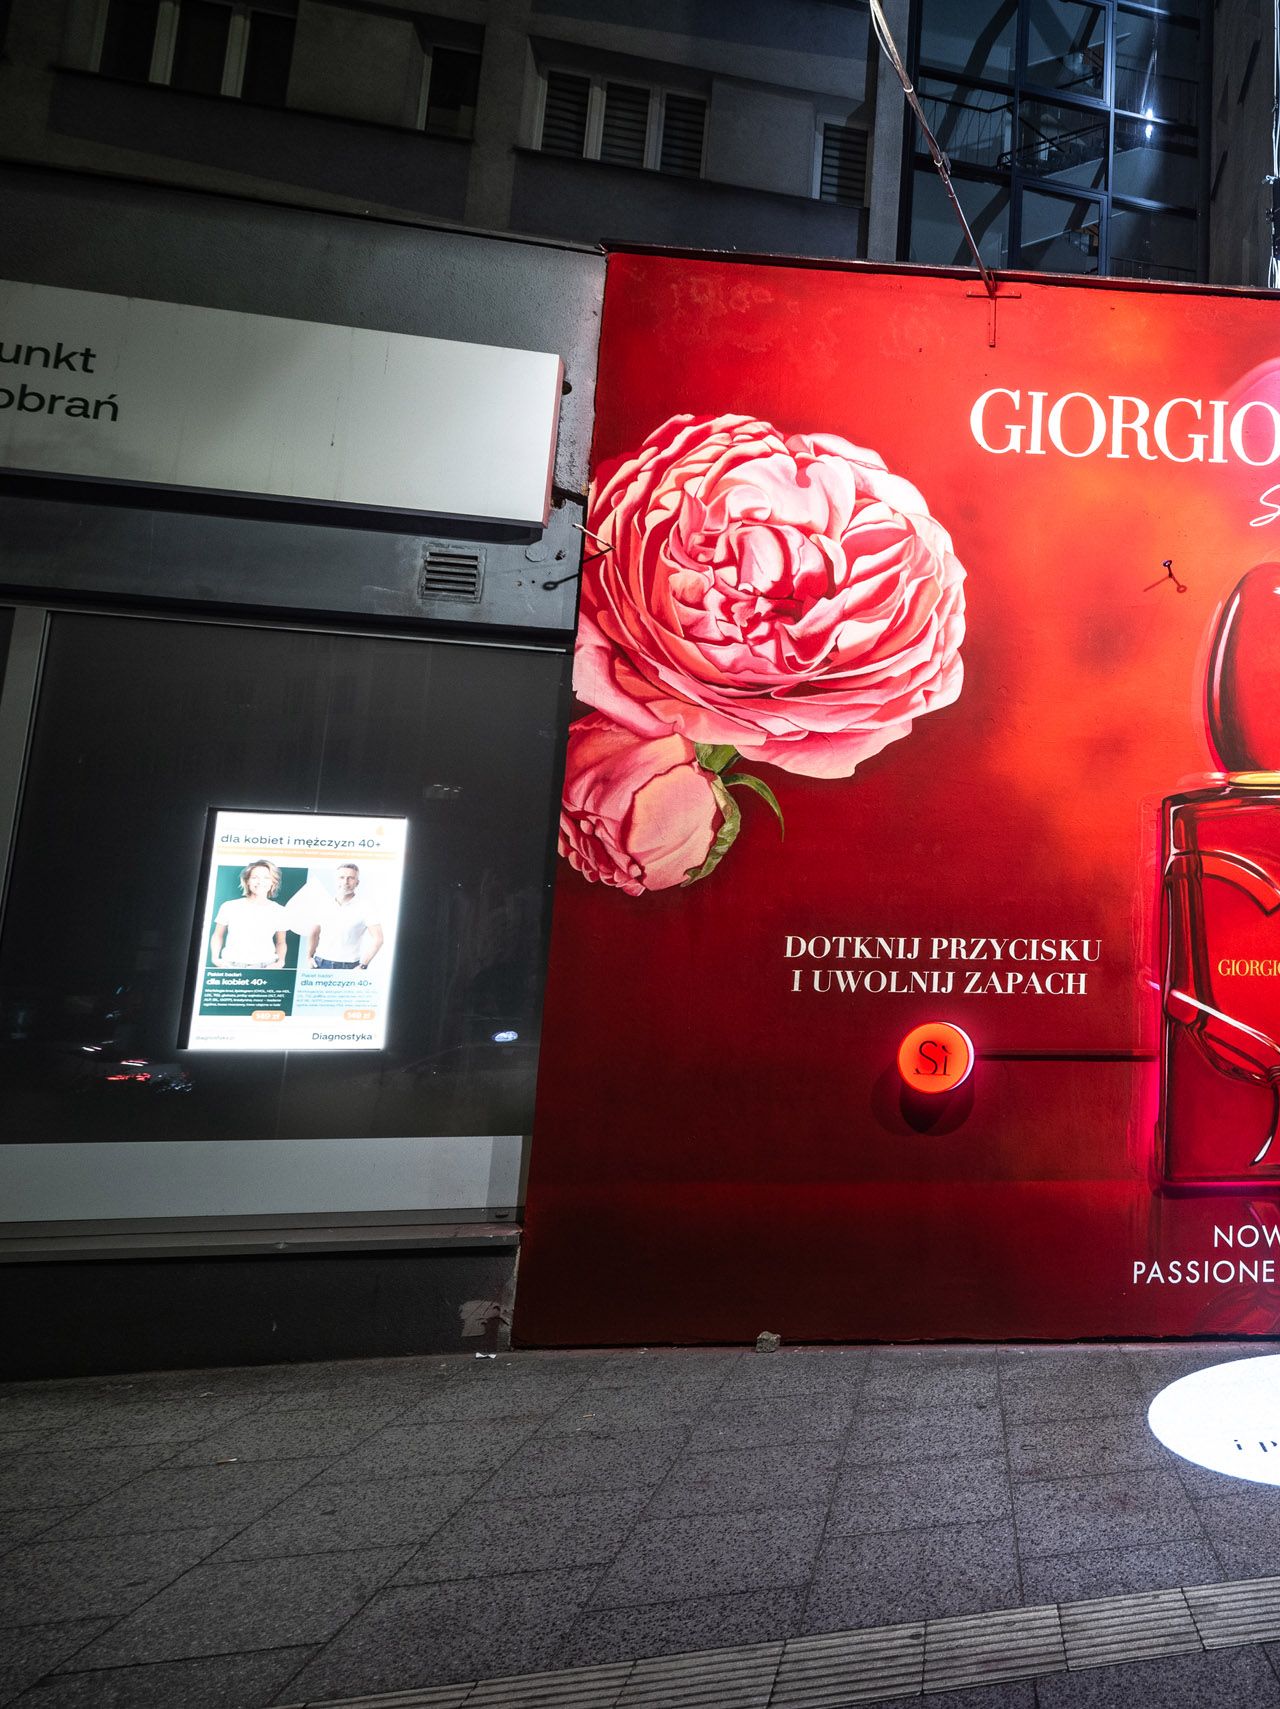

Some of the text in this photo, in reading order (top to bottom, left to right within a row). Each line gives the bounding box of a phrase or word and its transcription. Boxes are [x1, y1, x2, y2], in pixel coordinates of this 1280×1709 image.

[220, 834, 381, 850] dla kobiet i mężczyzn 40+
[784, 935, 1102, 962] DOTKNIJ PRZYCISKU
[206, 978, 268, 986] dla kobiet 40+
[300, 979, 373, 988] dla mężczyzn 40+
[791, 969, 1088, 995] I UWOLNIJ ZAPACH
[312, 1032, 373, 1042] Diagnostyka
[913, 1039, 952, 1075] Sì
[1133, 1260, 1275, 1284] PASSIONE
[1234, 1438, 1242, 1451] i
